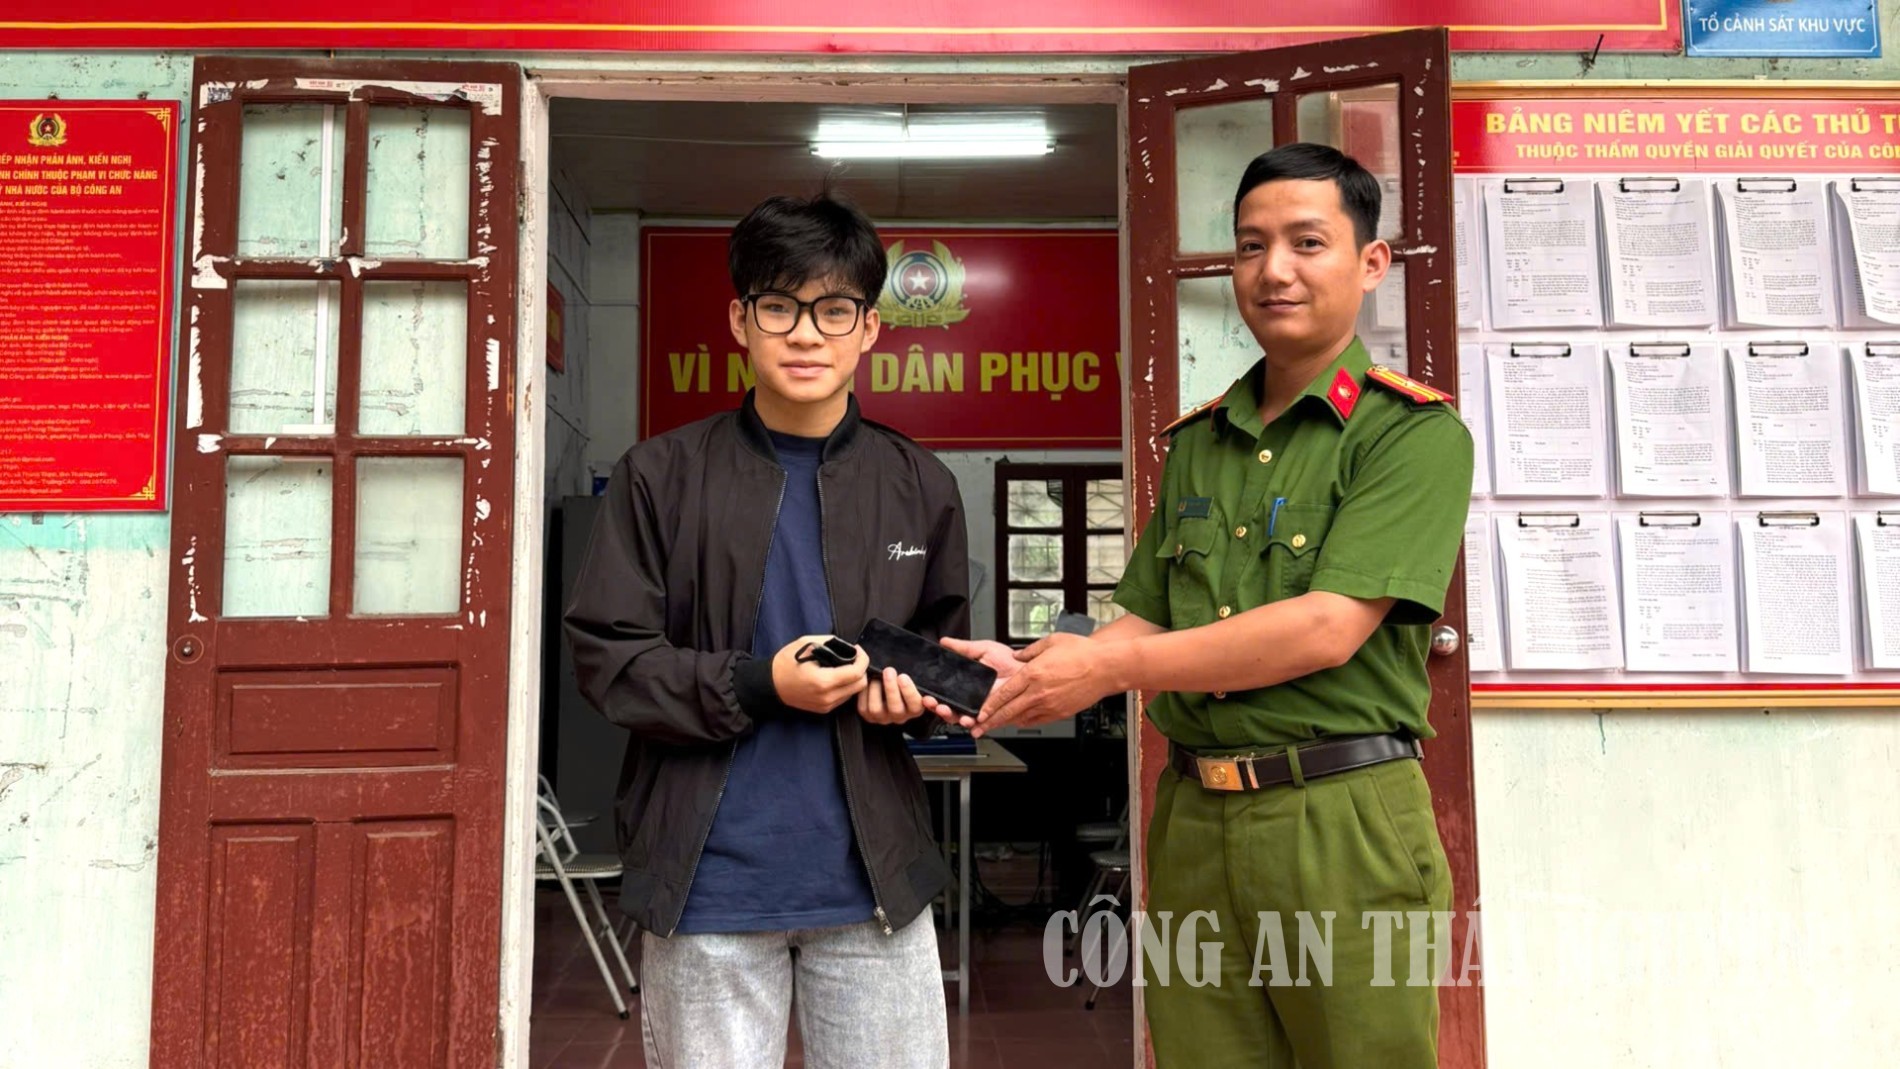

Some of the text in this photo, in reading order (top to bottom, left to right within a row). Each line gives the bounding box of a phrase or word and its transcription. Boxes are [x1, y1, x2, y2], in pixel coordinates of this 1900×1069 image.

[1699, 12, 1866, 35] TỔ CẢNH SÁT KHU VỰC
[1486, 106, 1574, 134] BẢNG
[1583, 109, 1666, 134] NIÊM
[1675, 106, 1731, 134] YẾT
[1740, 110, 1803, 135] CÁC
[1812, 107, 1872, 135] THỦ
[1515, 142, 1579, 162] THUỘC
[1584, 139, 1640, 159] THẨM
[1645, 139, 1709, 160] QUYỀN
[1715, 140, 1753, 159] GIẢI
[1759, 139, 1819, 160] QUYẾT
[1824, 141, 1863, 159] CỦA
[98, 169, 107, 180] VI
[109, 184, 123, 195] AN
[668, 343, 711, 393] VÌ
[871, 343, 964, 393] DÂN
[980, 350, 1100, 401] PHỤC
